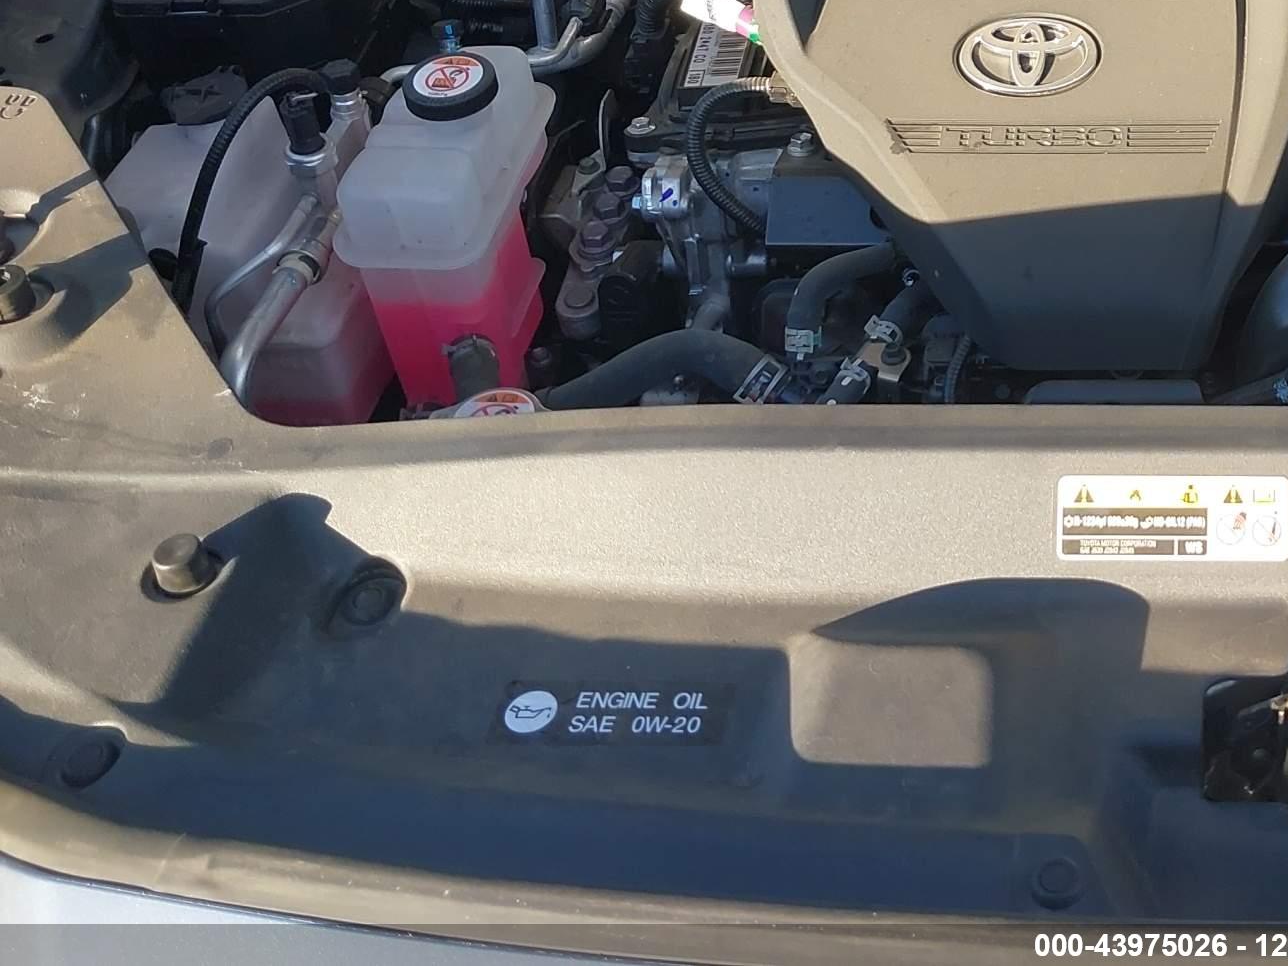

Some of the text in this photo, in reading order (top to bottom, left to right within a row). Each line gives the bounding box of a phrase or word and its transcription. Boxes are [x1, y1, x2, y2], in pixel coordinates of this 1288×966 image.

[945, 126, 1125, 147] TURBO
[575, 691, 709, 710] ENGINE OIL
[568, 715, 702, 733] SAE 0W-20
